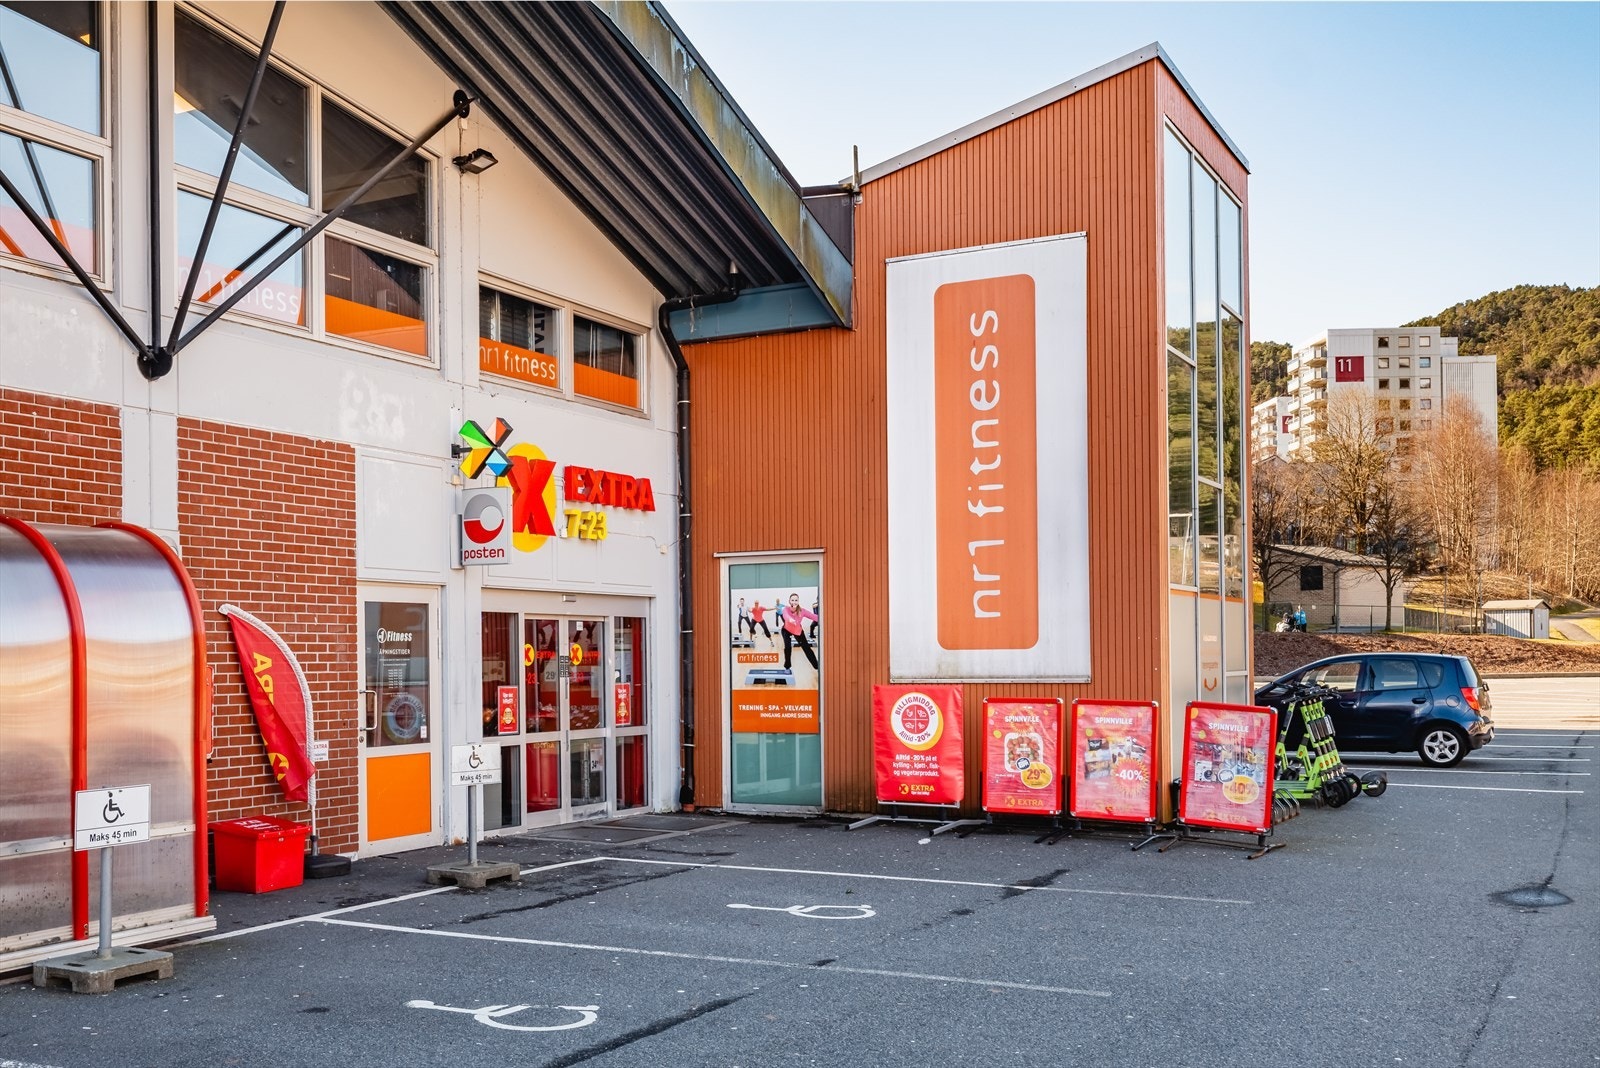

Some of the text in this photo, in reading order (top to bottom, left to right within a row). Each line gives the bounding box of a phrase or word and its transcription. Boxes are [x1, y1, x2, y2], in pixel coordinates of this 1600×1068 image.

[503, 349, 556, 380] fitness
[1337, 358, 1352, 372] 11
[967, 309, 1006, 619] nr1 fitness
[564, 464, 656, 512] EXTRA
[564, 508, 608, 541] 7-23
[463, 546, 505, 560] posten
[386, 630, 413, 642] Fitness
[739, 654, 778, 662] nr1 fitness
[894, 696, 936, 716] BILLIGMIDDAG
[1094, 717, 1133, 725] SPINNVILLE
[1208, 722, 1249, 733] SPINNVILLE
[899, 730, 931, 742] Alltid -20%
[1115, 769, 1143, 781] -40%
[1017, 799, 1044, 807] EXTRA
[89, 828, 137, 842] Maks 45 min
